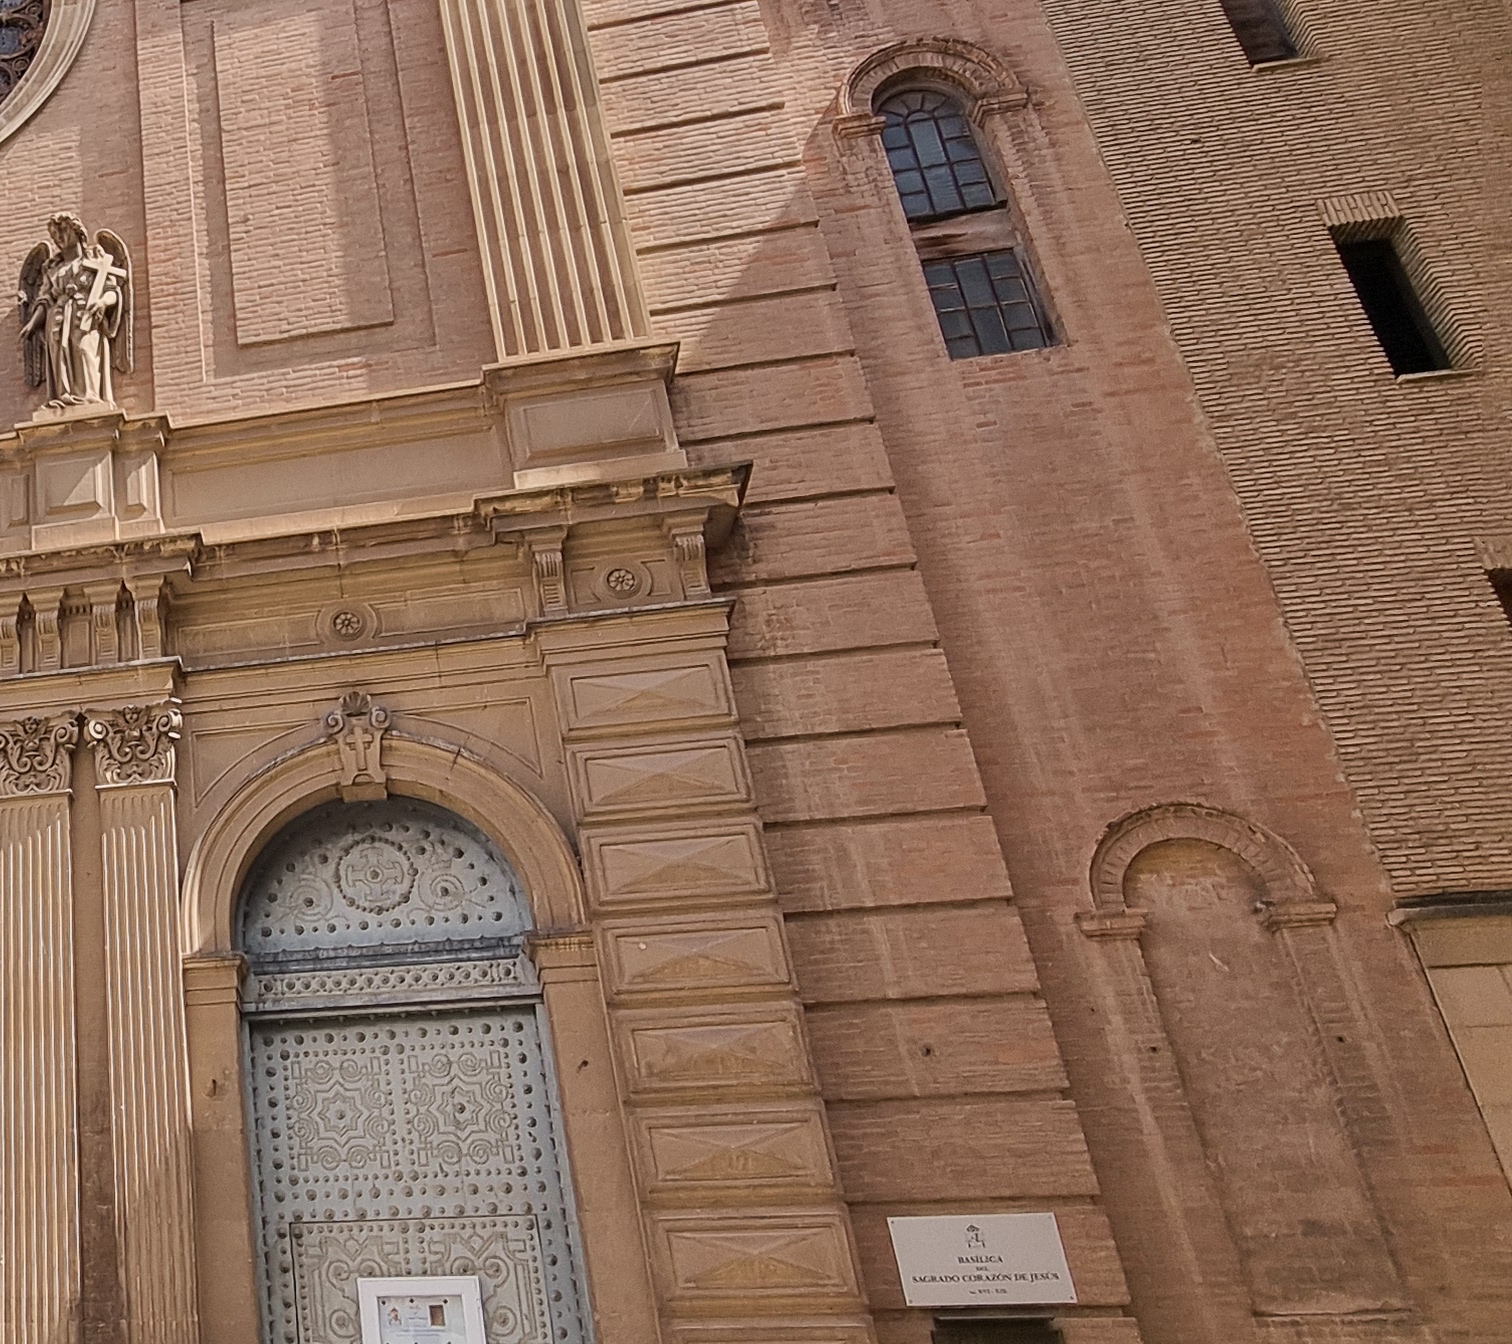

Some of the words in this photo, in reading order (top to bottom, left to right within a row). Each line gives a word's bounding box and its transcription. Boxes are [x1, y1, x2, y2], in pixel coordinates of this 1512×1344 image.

[912, 1274, 960, 1284] SAGRADO
[962, 1272, 1012, 1283] CORAZÓN
[1014, 1273, 1027, 1282] DE
[1030, 1272, 1060, 1283] JESÚS
